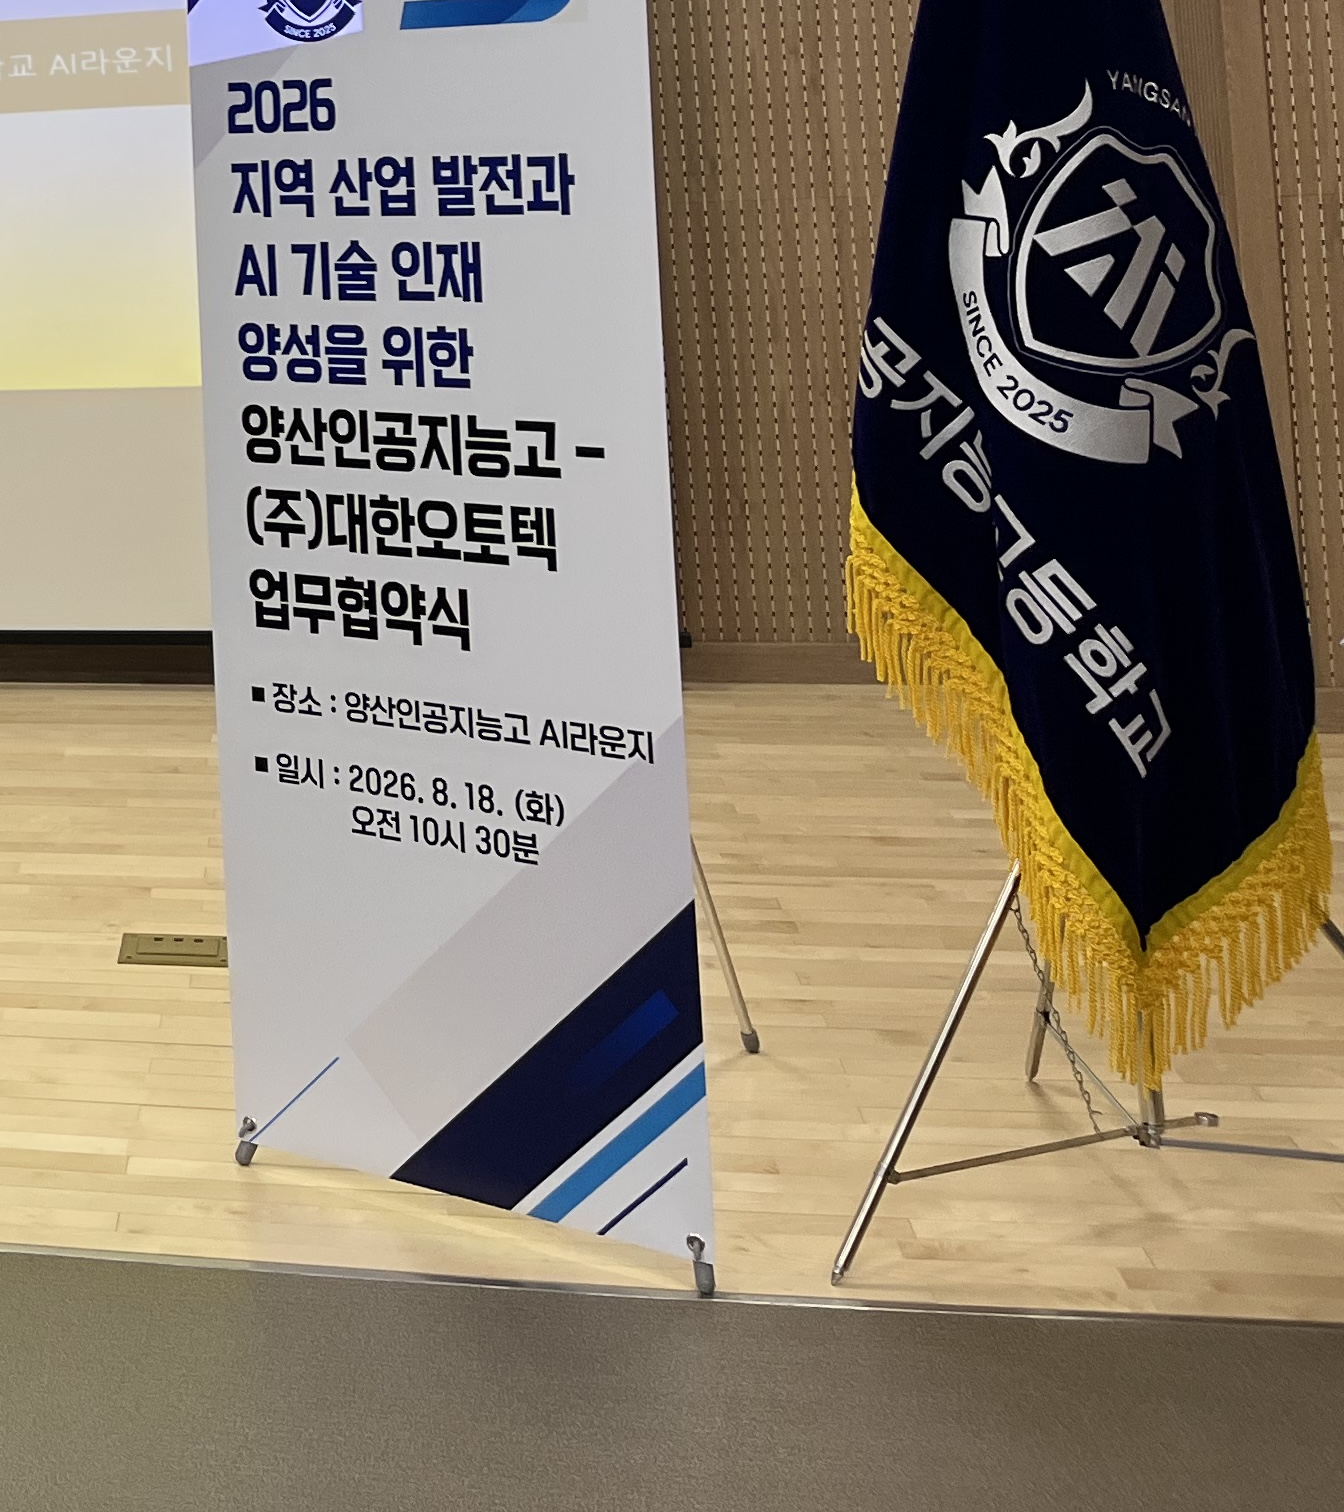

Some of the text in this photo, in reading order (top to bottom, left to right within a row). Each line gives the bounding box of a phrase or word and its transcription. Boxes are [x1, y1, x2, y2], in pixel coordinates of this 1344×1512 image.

[48, 44, 174, 77] AI라운지
[284, 23, 337, 39] SINCE 2025
[227, 78, 337, 134] 2026
[230, 153, 576, 218] 지역 산업 발전과
[234, 240, 484, 303] AI 기술 인재
[238, 322, 474, 389] 양성을 위한
[963, 290, 1074, 433] SINCE 2025
[241, 403, 606, 479] 양산인공지능고 -
[246, 485, 559, 572] (주)대한오토텍
[248, 568, 472, 652] 업무협약식
[272, 682, 655, 765] 장소 : 양산인공지능고 AI라운지
[275, 753, 565, 827] 일시 : 2026. 8. 18. (화)
[351, 805, 540, 865] 오전 10시 30분
